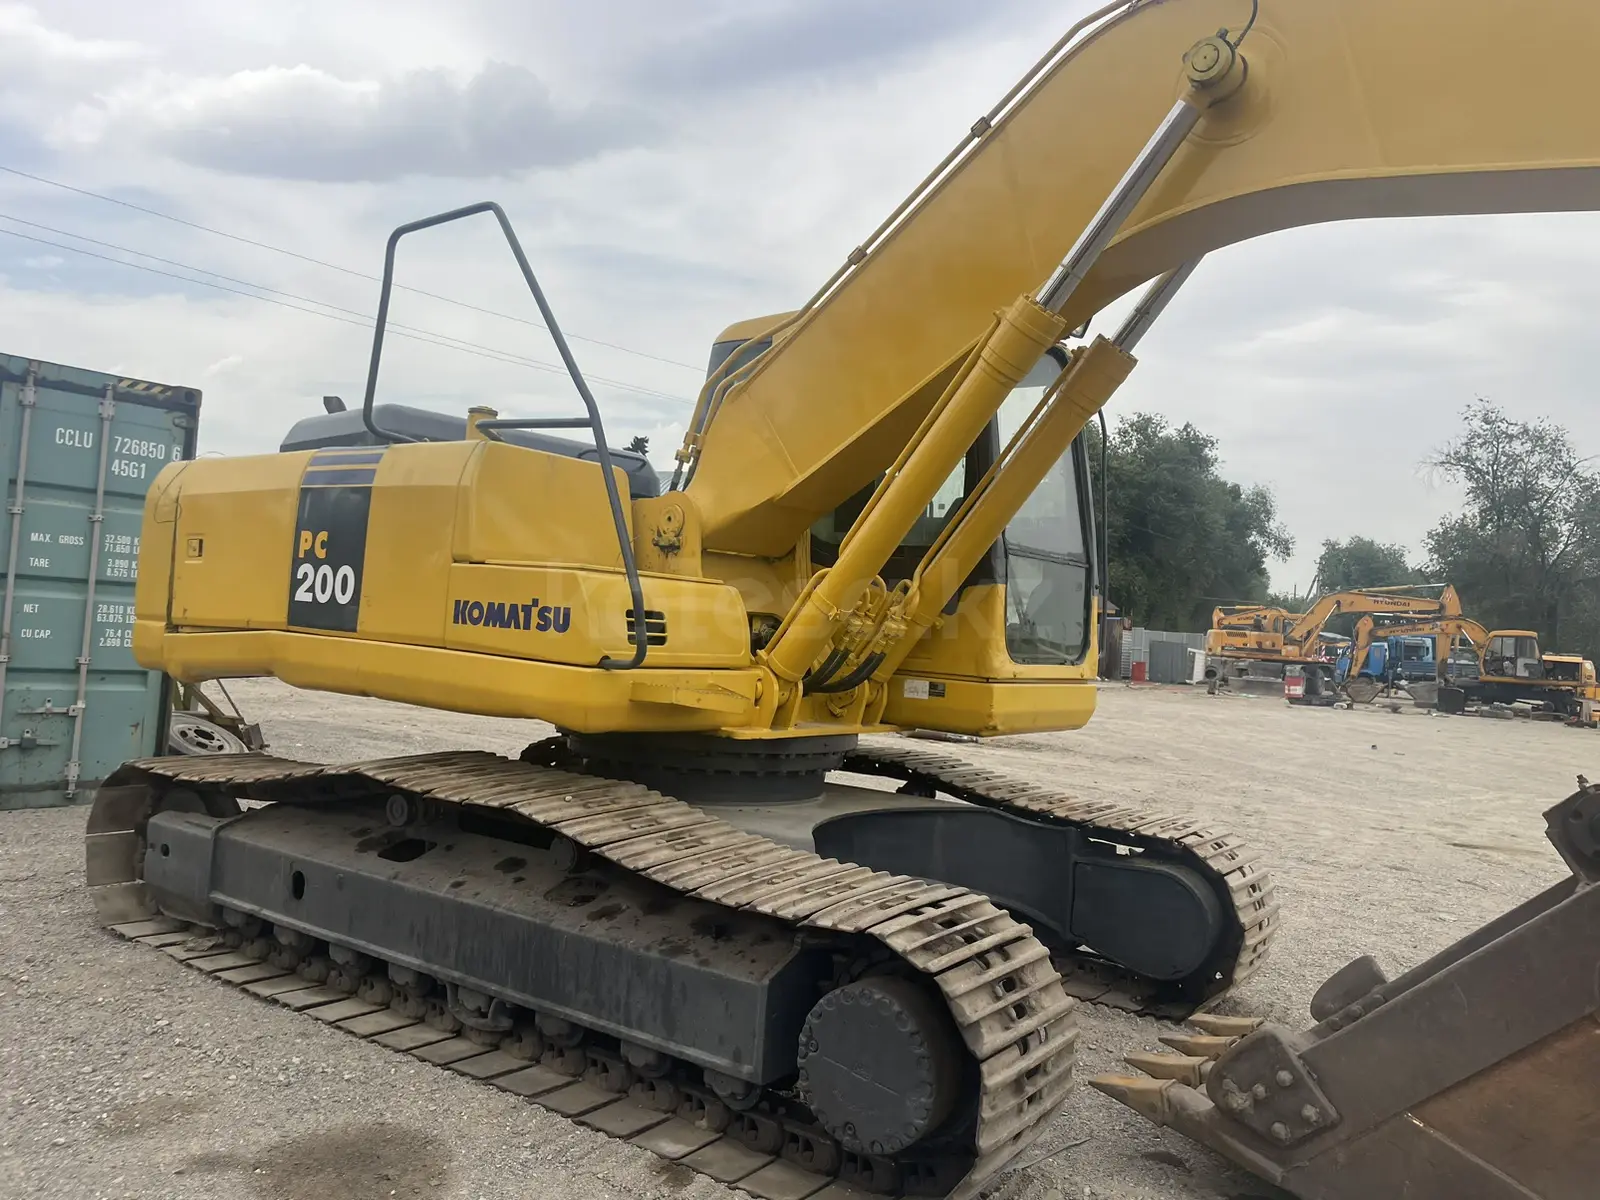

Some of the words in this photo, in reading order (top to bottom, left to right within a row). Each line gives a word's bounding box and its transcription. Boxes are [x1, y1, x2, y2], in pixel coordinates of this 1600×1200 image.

[55, 427, 94, 449] CCLU
[113, 436, 166, 461] 726850
[172, 446, 182, 462] 6
[111, 459, 147, 479] 45G1
[59, 534, 84, 546] GROSS
[298, 530, 329, 559] PC
[29, 557, 50, 568] TARE
[294, 563, 356, 605] 200
[23, 603, 40, 614] NET
[1373, 599, 1411, 607] HYUNDAI
[452, 598, 571, 633] KOMATSU
[105, 628, 122, 638] 76.4
